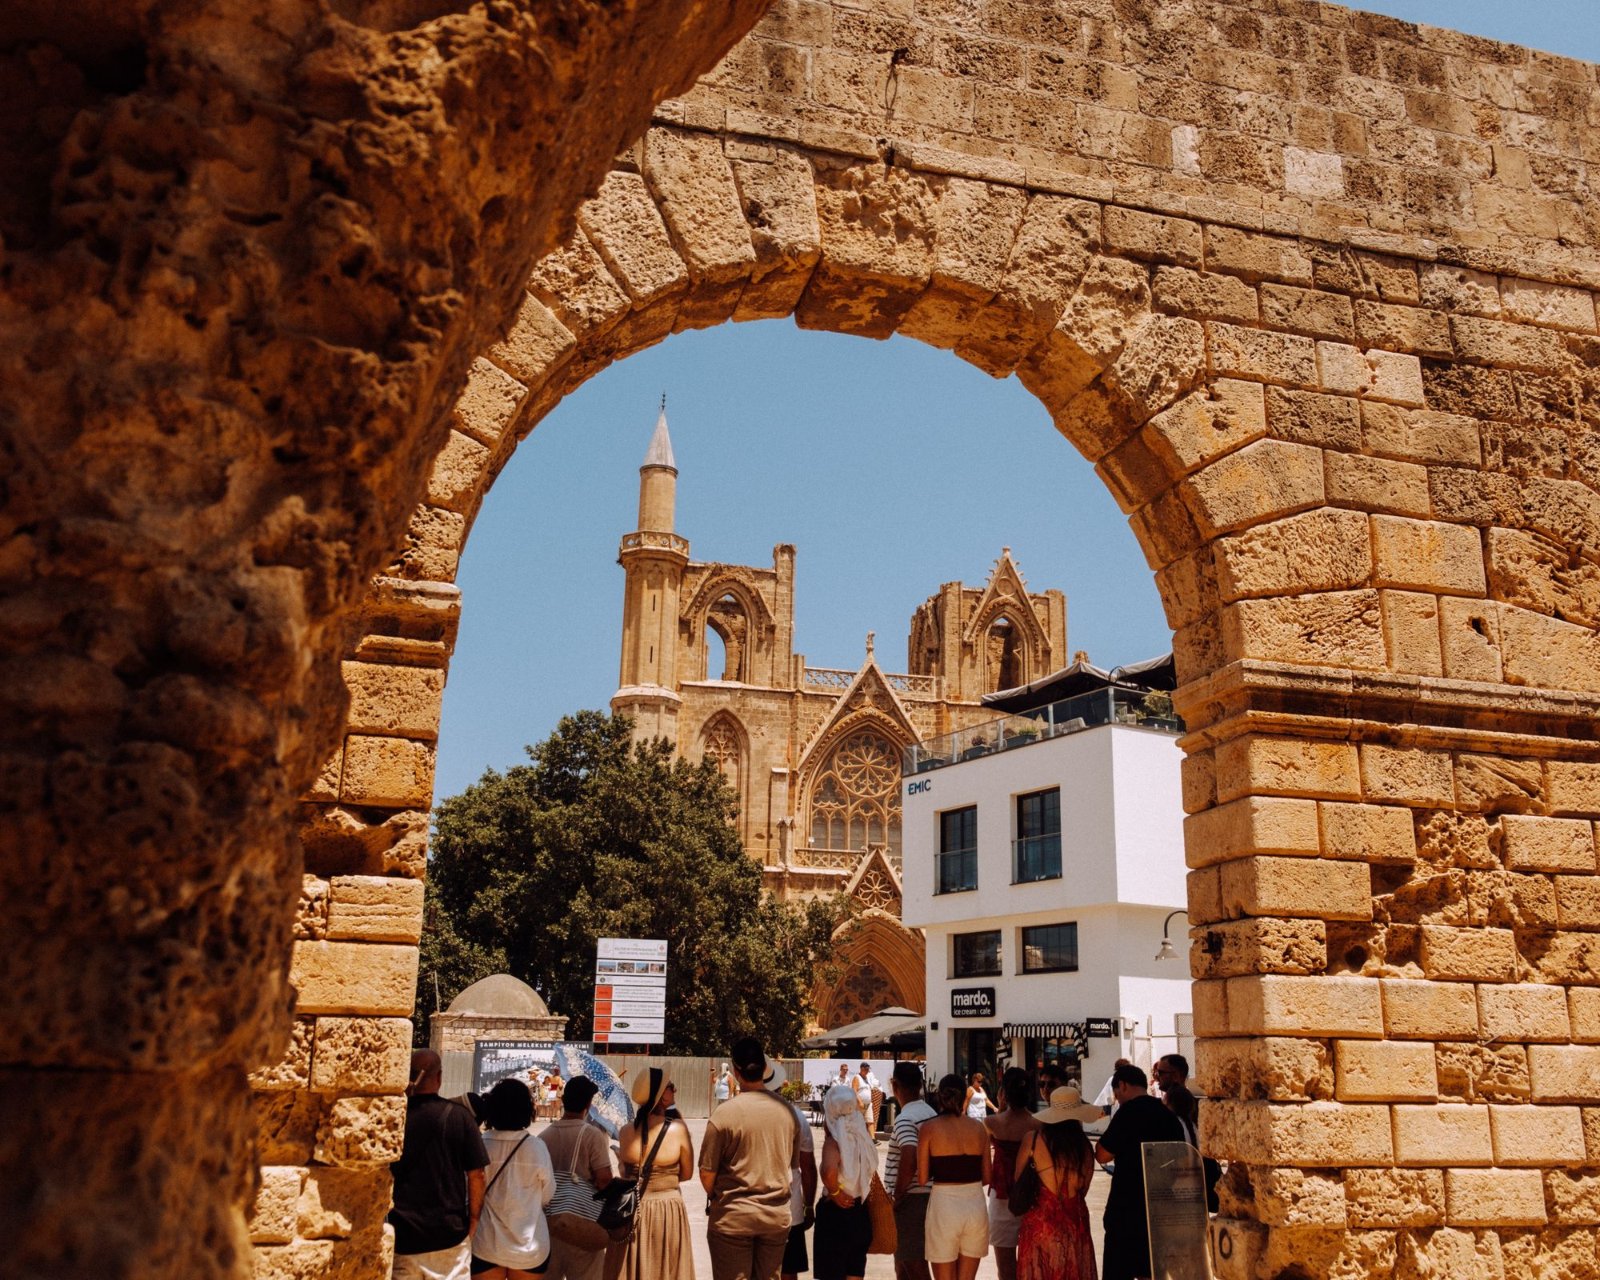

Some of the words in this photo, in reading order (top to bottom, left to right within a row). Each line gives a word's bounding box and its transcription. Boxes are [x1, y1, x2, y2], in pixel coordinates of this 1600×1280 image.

[908, 779, 931, 795] EMIC
[953, 990, 990, 1006] mardo.
[980, 1007, 991, 1015] cafe
